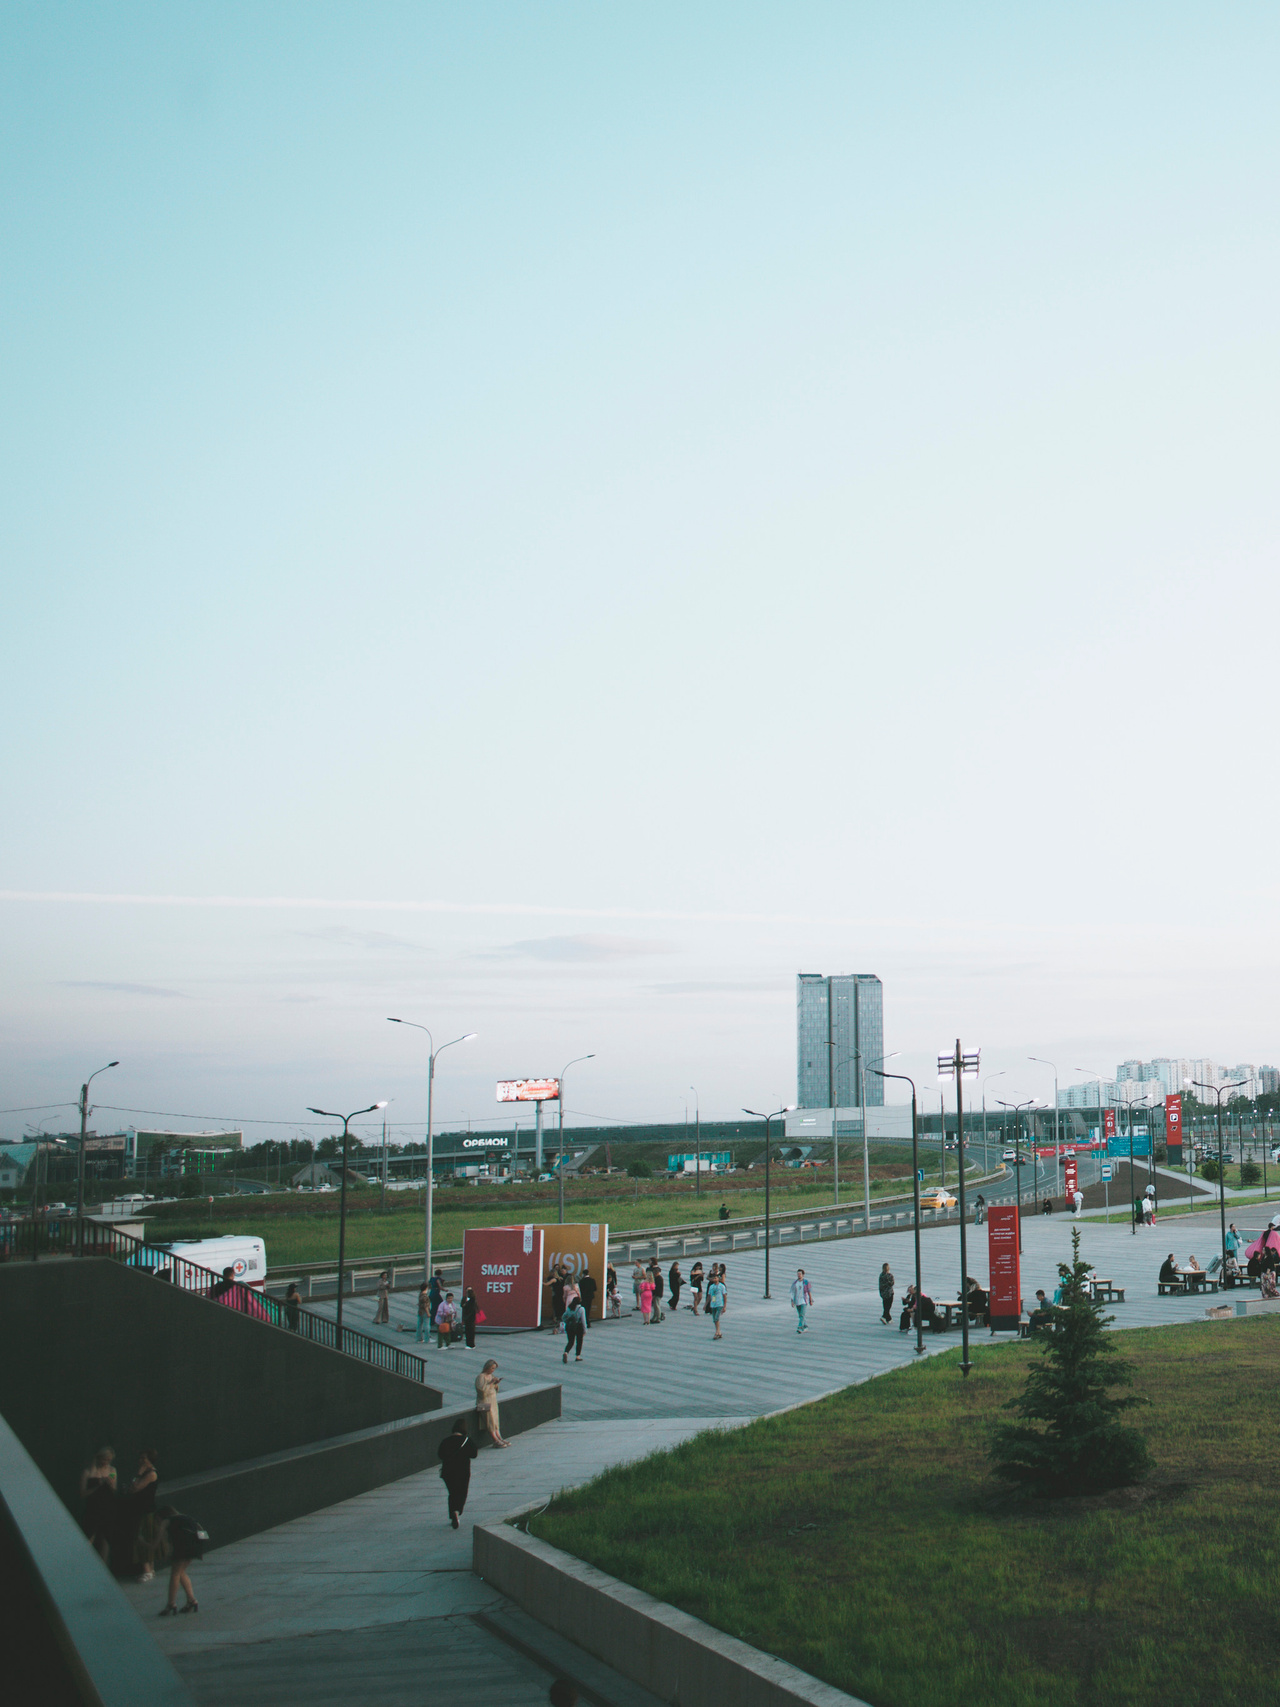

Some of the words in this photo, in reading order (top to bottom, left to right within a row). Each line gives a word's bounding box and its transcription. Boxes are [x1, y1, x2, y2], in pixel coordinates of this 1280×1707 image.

[463, 1138, 508, 1147] ОРБИОН
[481, 1264, 520, 1276] SMART
[486, 1282, 513, 1293] FEST
